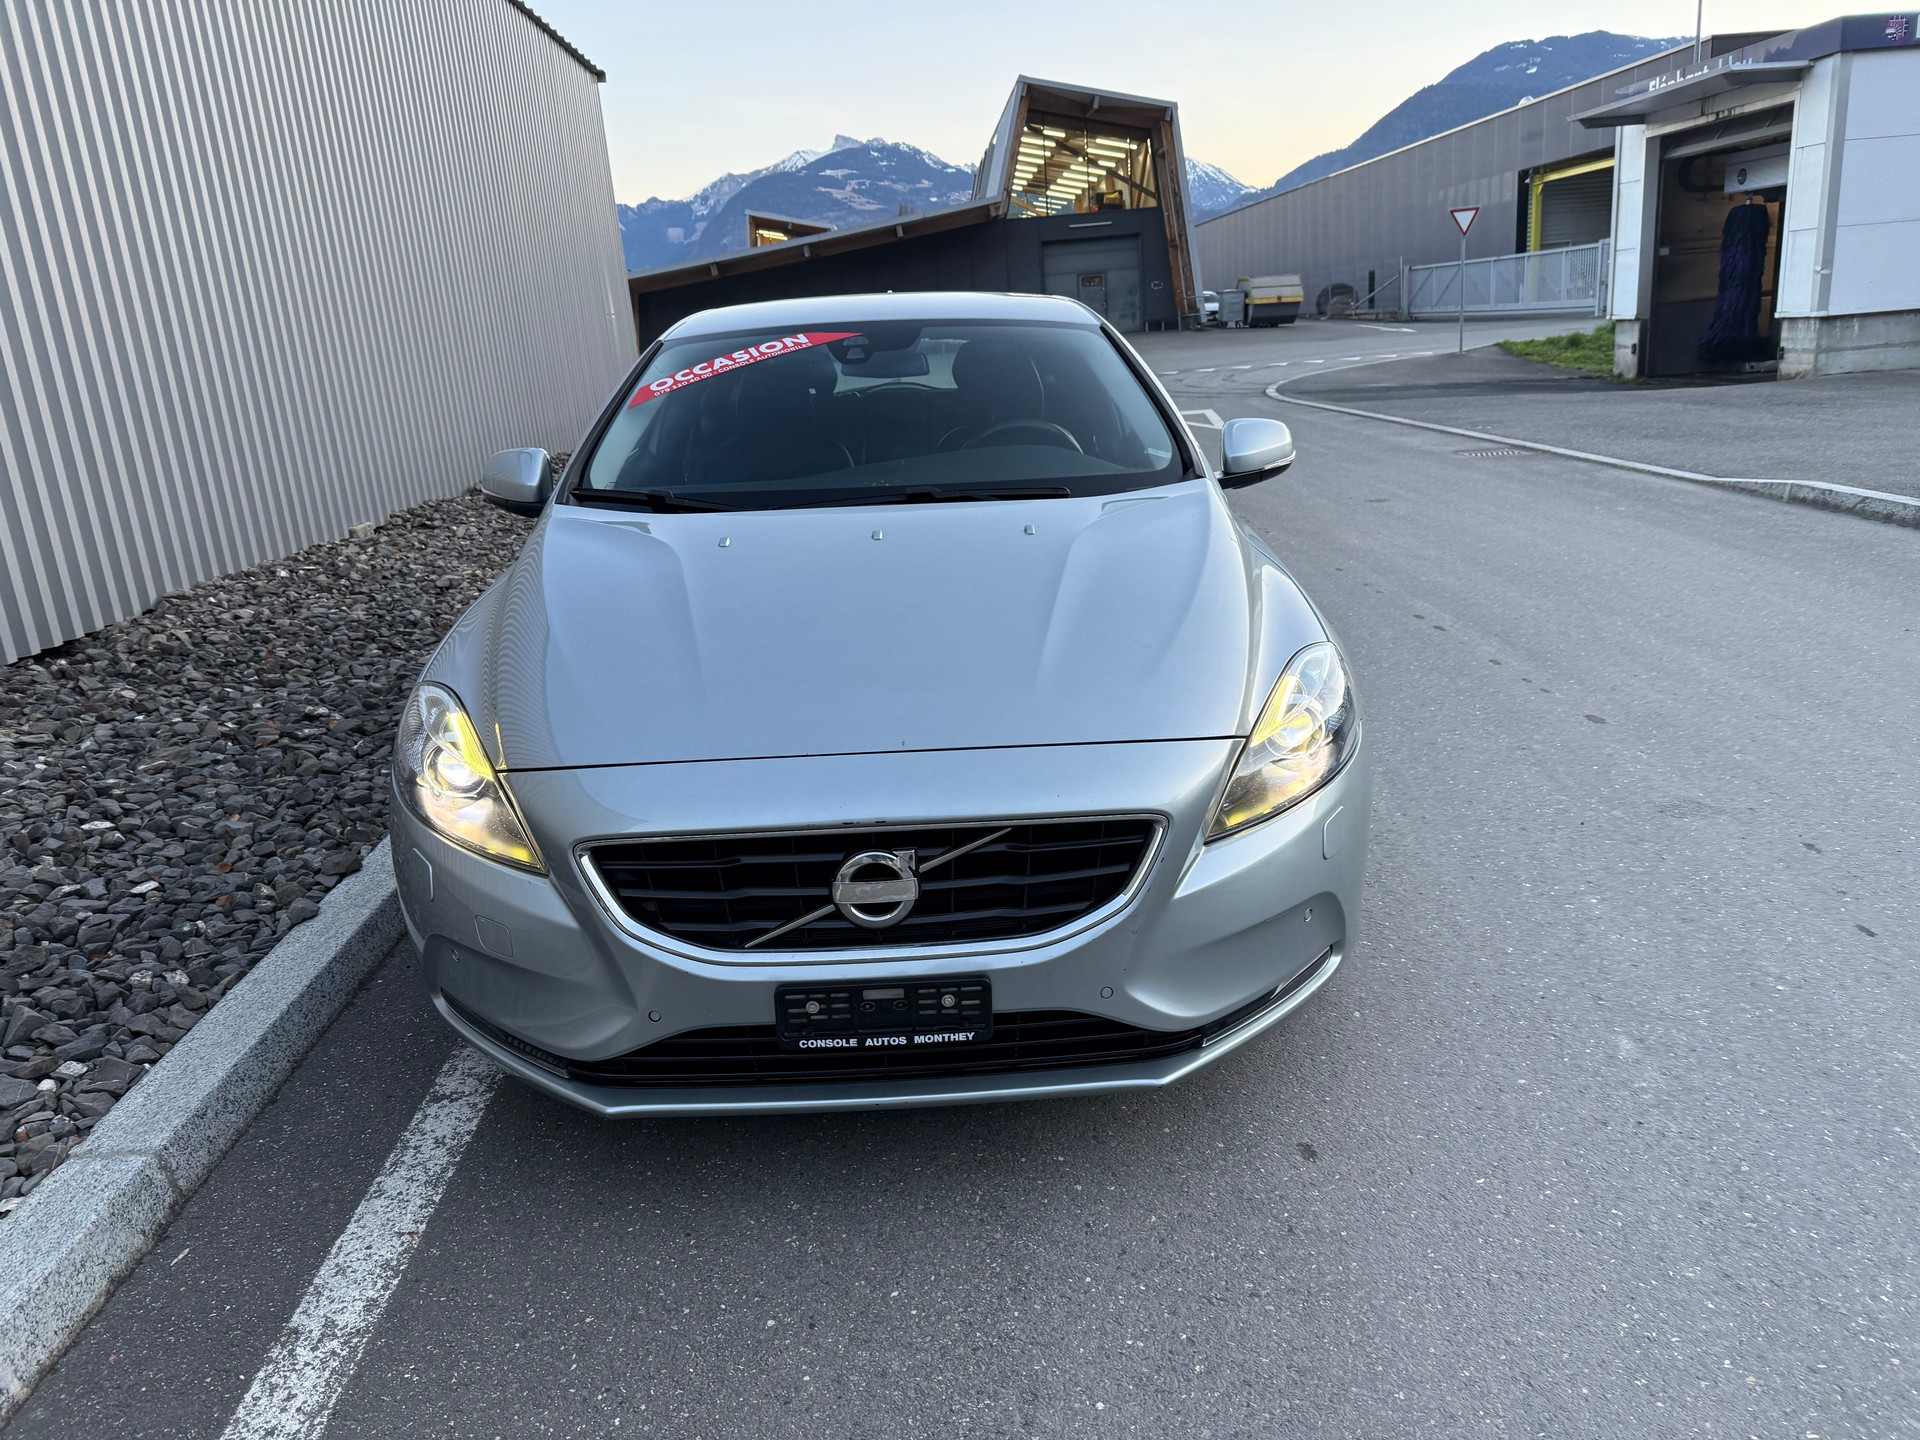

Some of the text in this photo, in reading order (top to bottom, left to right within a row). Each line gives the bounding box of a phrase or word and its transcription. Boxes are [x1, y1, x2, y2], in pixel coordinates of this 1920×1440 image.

[649, 333, 810, 391] OCCASION
[718, 358, 756, 373] CONSOLE
[756, 342, 813, 361] AUTOMOBILES
[799, 1031, 976, 1049] CONSOLE AUTOS MONTHEY
